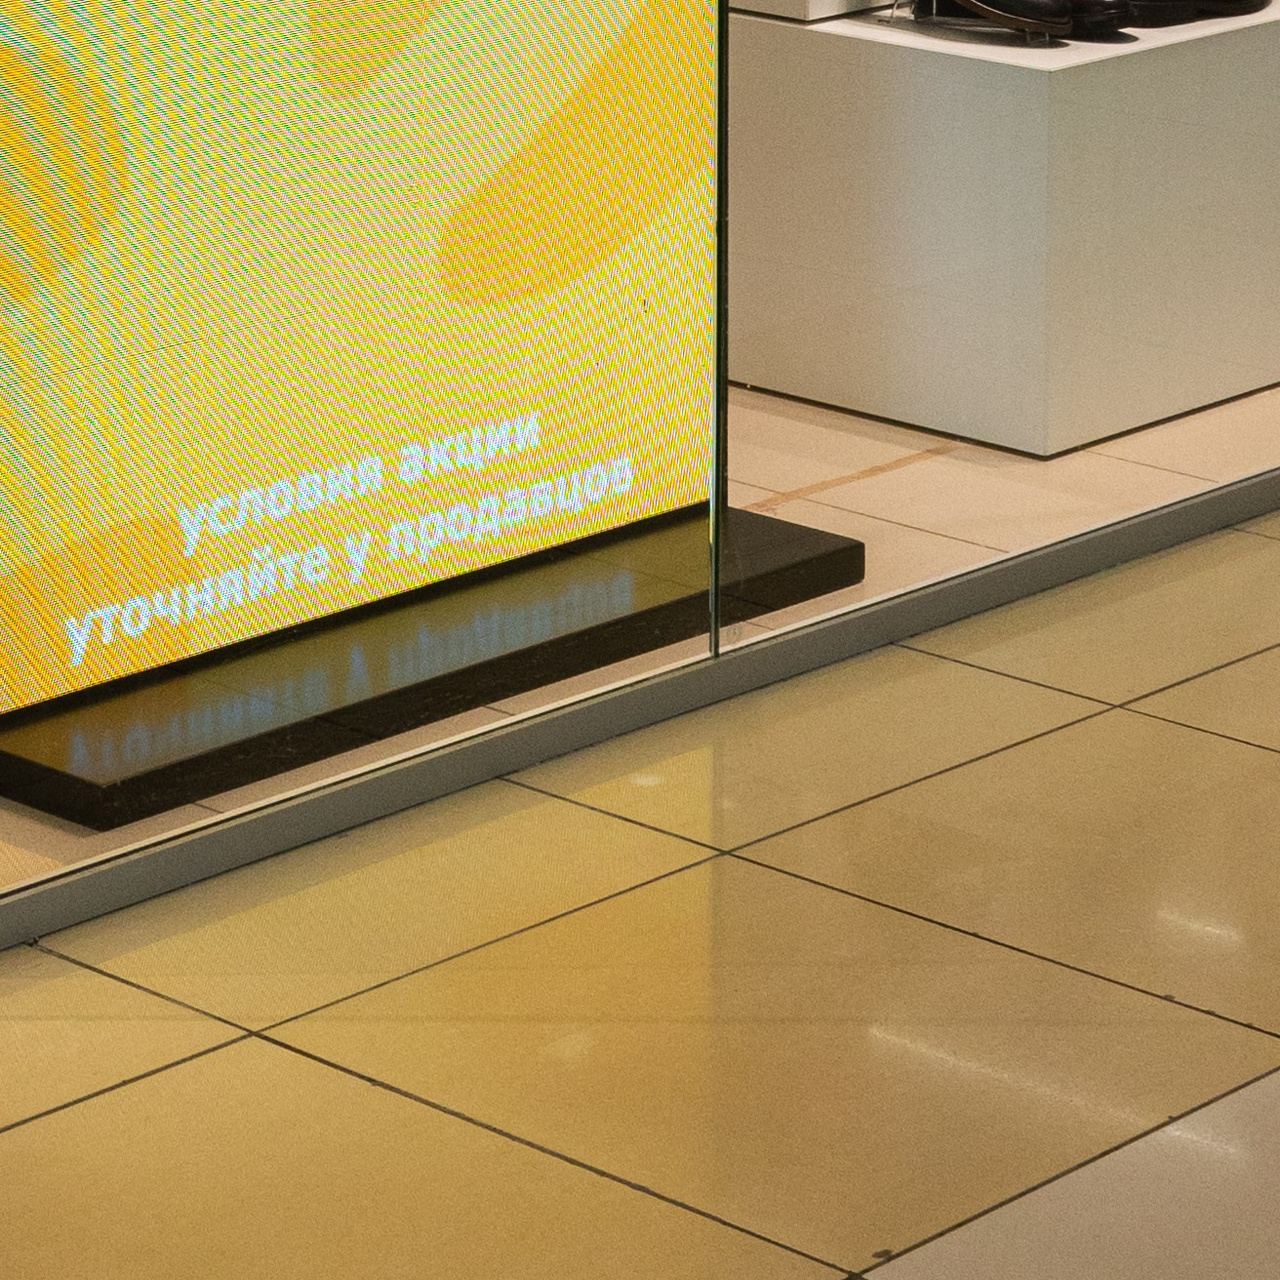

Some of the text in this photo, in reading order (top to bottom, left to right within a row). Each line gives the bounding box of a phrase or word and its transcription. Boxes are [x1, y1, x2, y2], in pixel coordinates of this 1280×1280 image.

[63, 453, 637, 666] уточняйте у продавцов
[177, 410, 541, 557] условия акции
